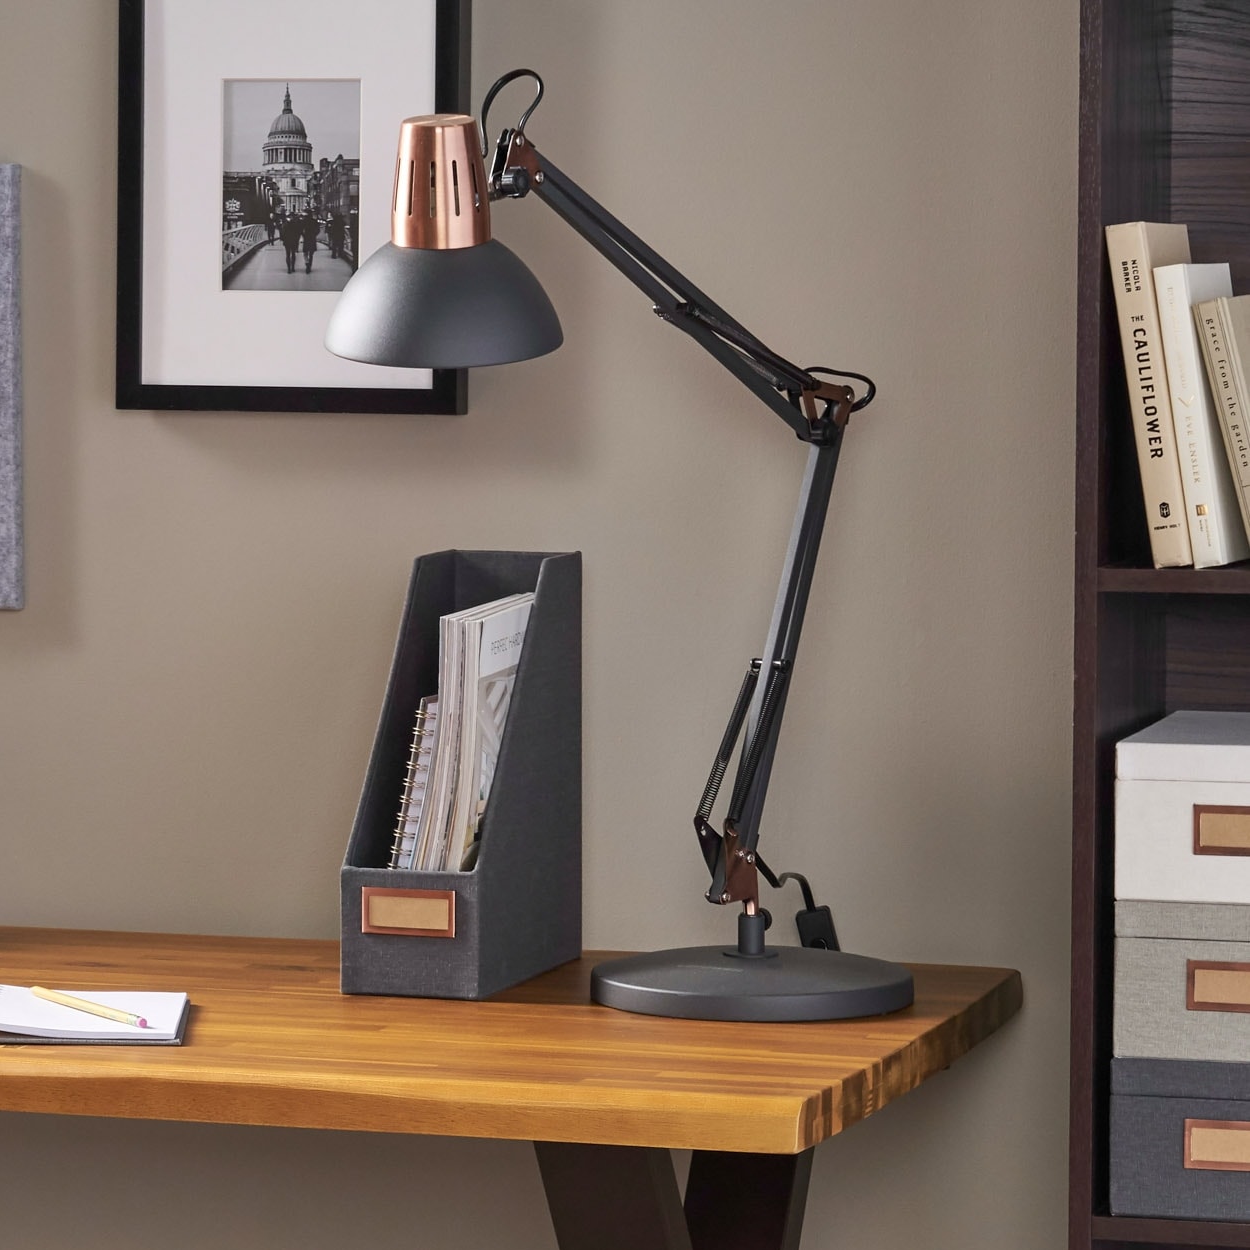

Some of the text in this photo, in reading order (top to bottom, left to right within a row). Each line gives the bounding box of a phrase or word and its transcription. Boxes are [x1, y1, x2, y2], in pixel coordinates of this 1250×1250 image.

[1121, 261, 1132, 293] BARKER
[1131, 259, 1141, 291] NICOLA
[1133, 328, 1164, 459] CAULIFLOWER
[1205, 318, 1249, 467] grace from the garden
